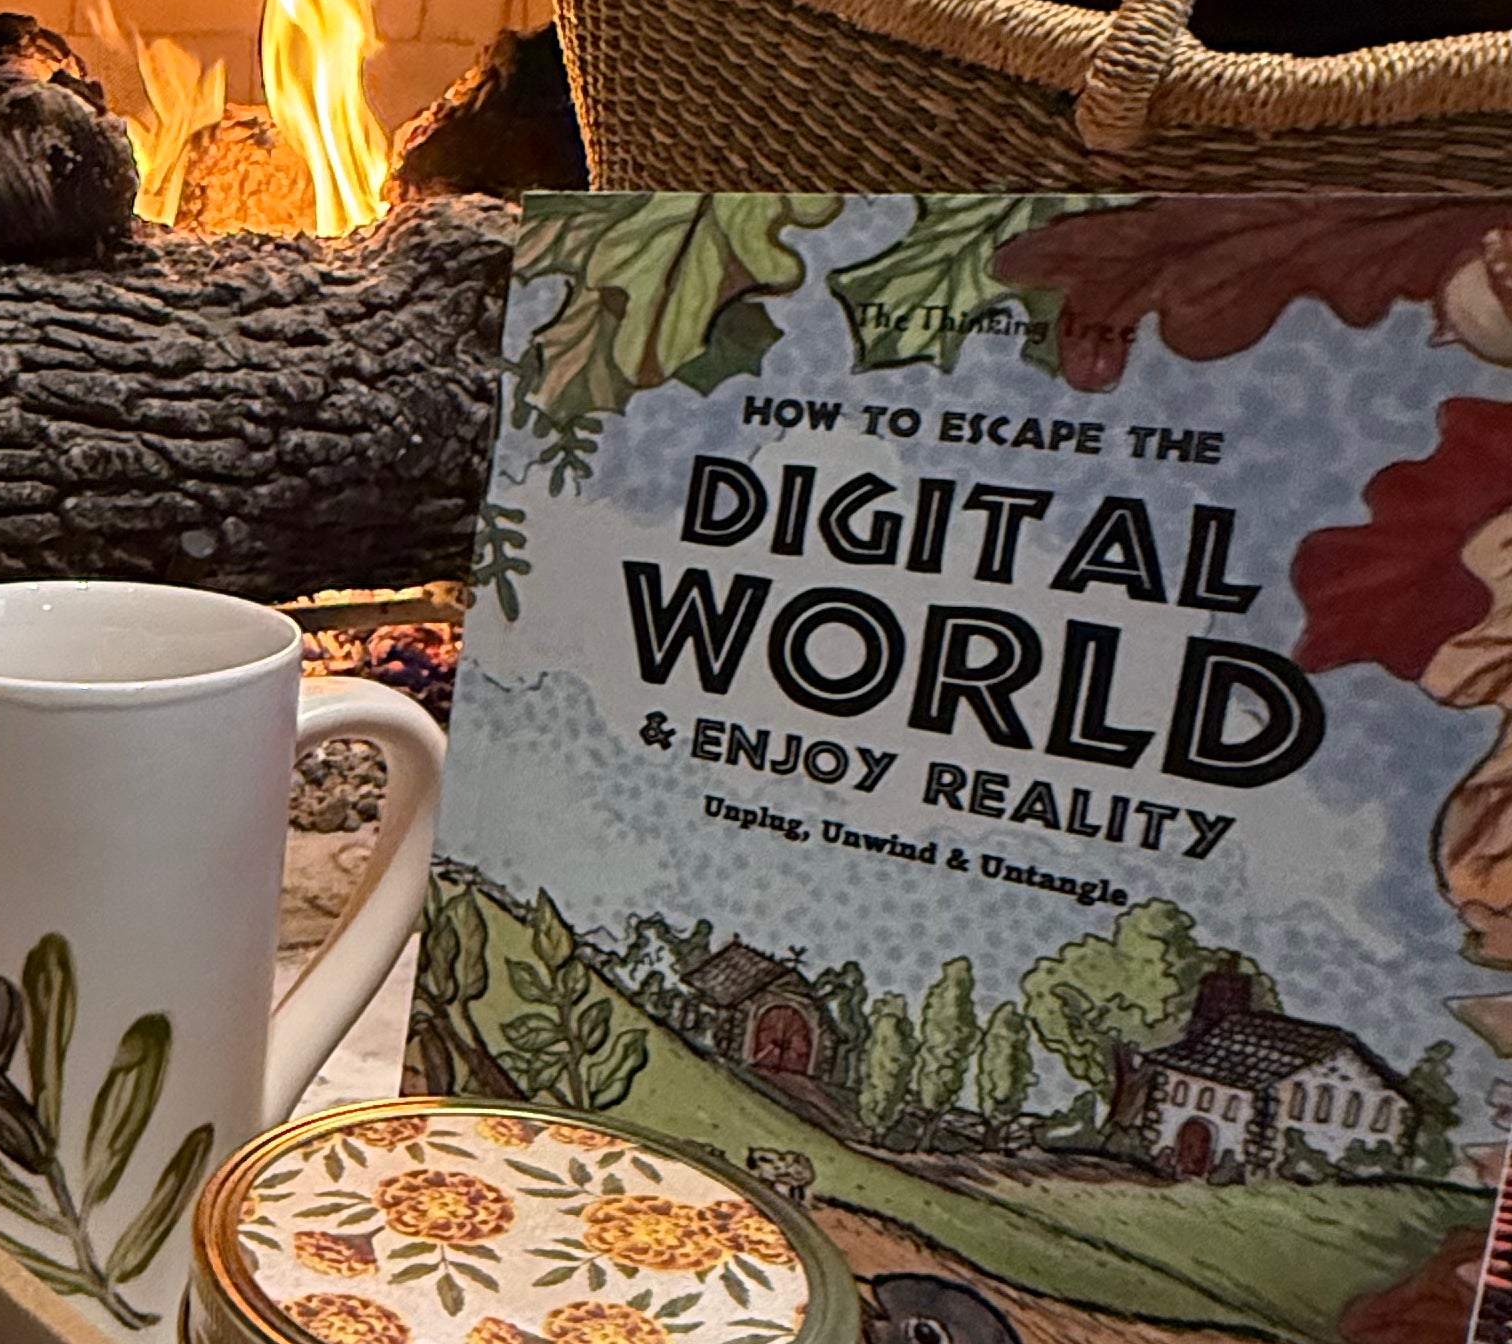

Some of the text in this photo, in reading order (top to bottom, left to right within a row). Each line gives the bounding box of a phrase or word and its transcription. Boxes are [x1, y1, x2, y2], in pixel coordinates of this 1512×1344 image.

[856, 302, 1138, 345] The Thinking Tree
[742, 395, 1226, 466] HOW TO ESCAPE THE
[679, 453, 1263, 614] DIGITAL
[622, 559, 1326, 789] WORLD
[639, 711, 1236, 860] & ENJOY REALITY
[704, 794, 1128, 907] Unplug, Unwind & Untangle
